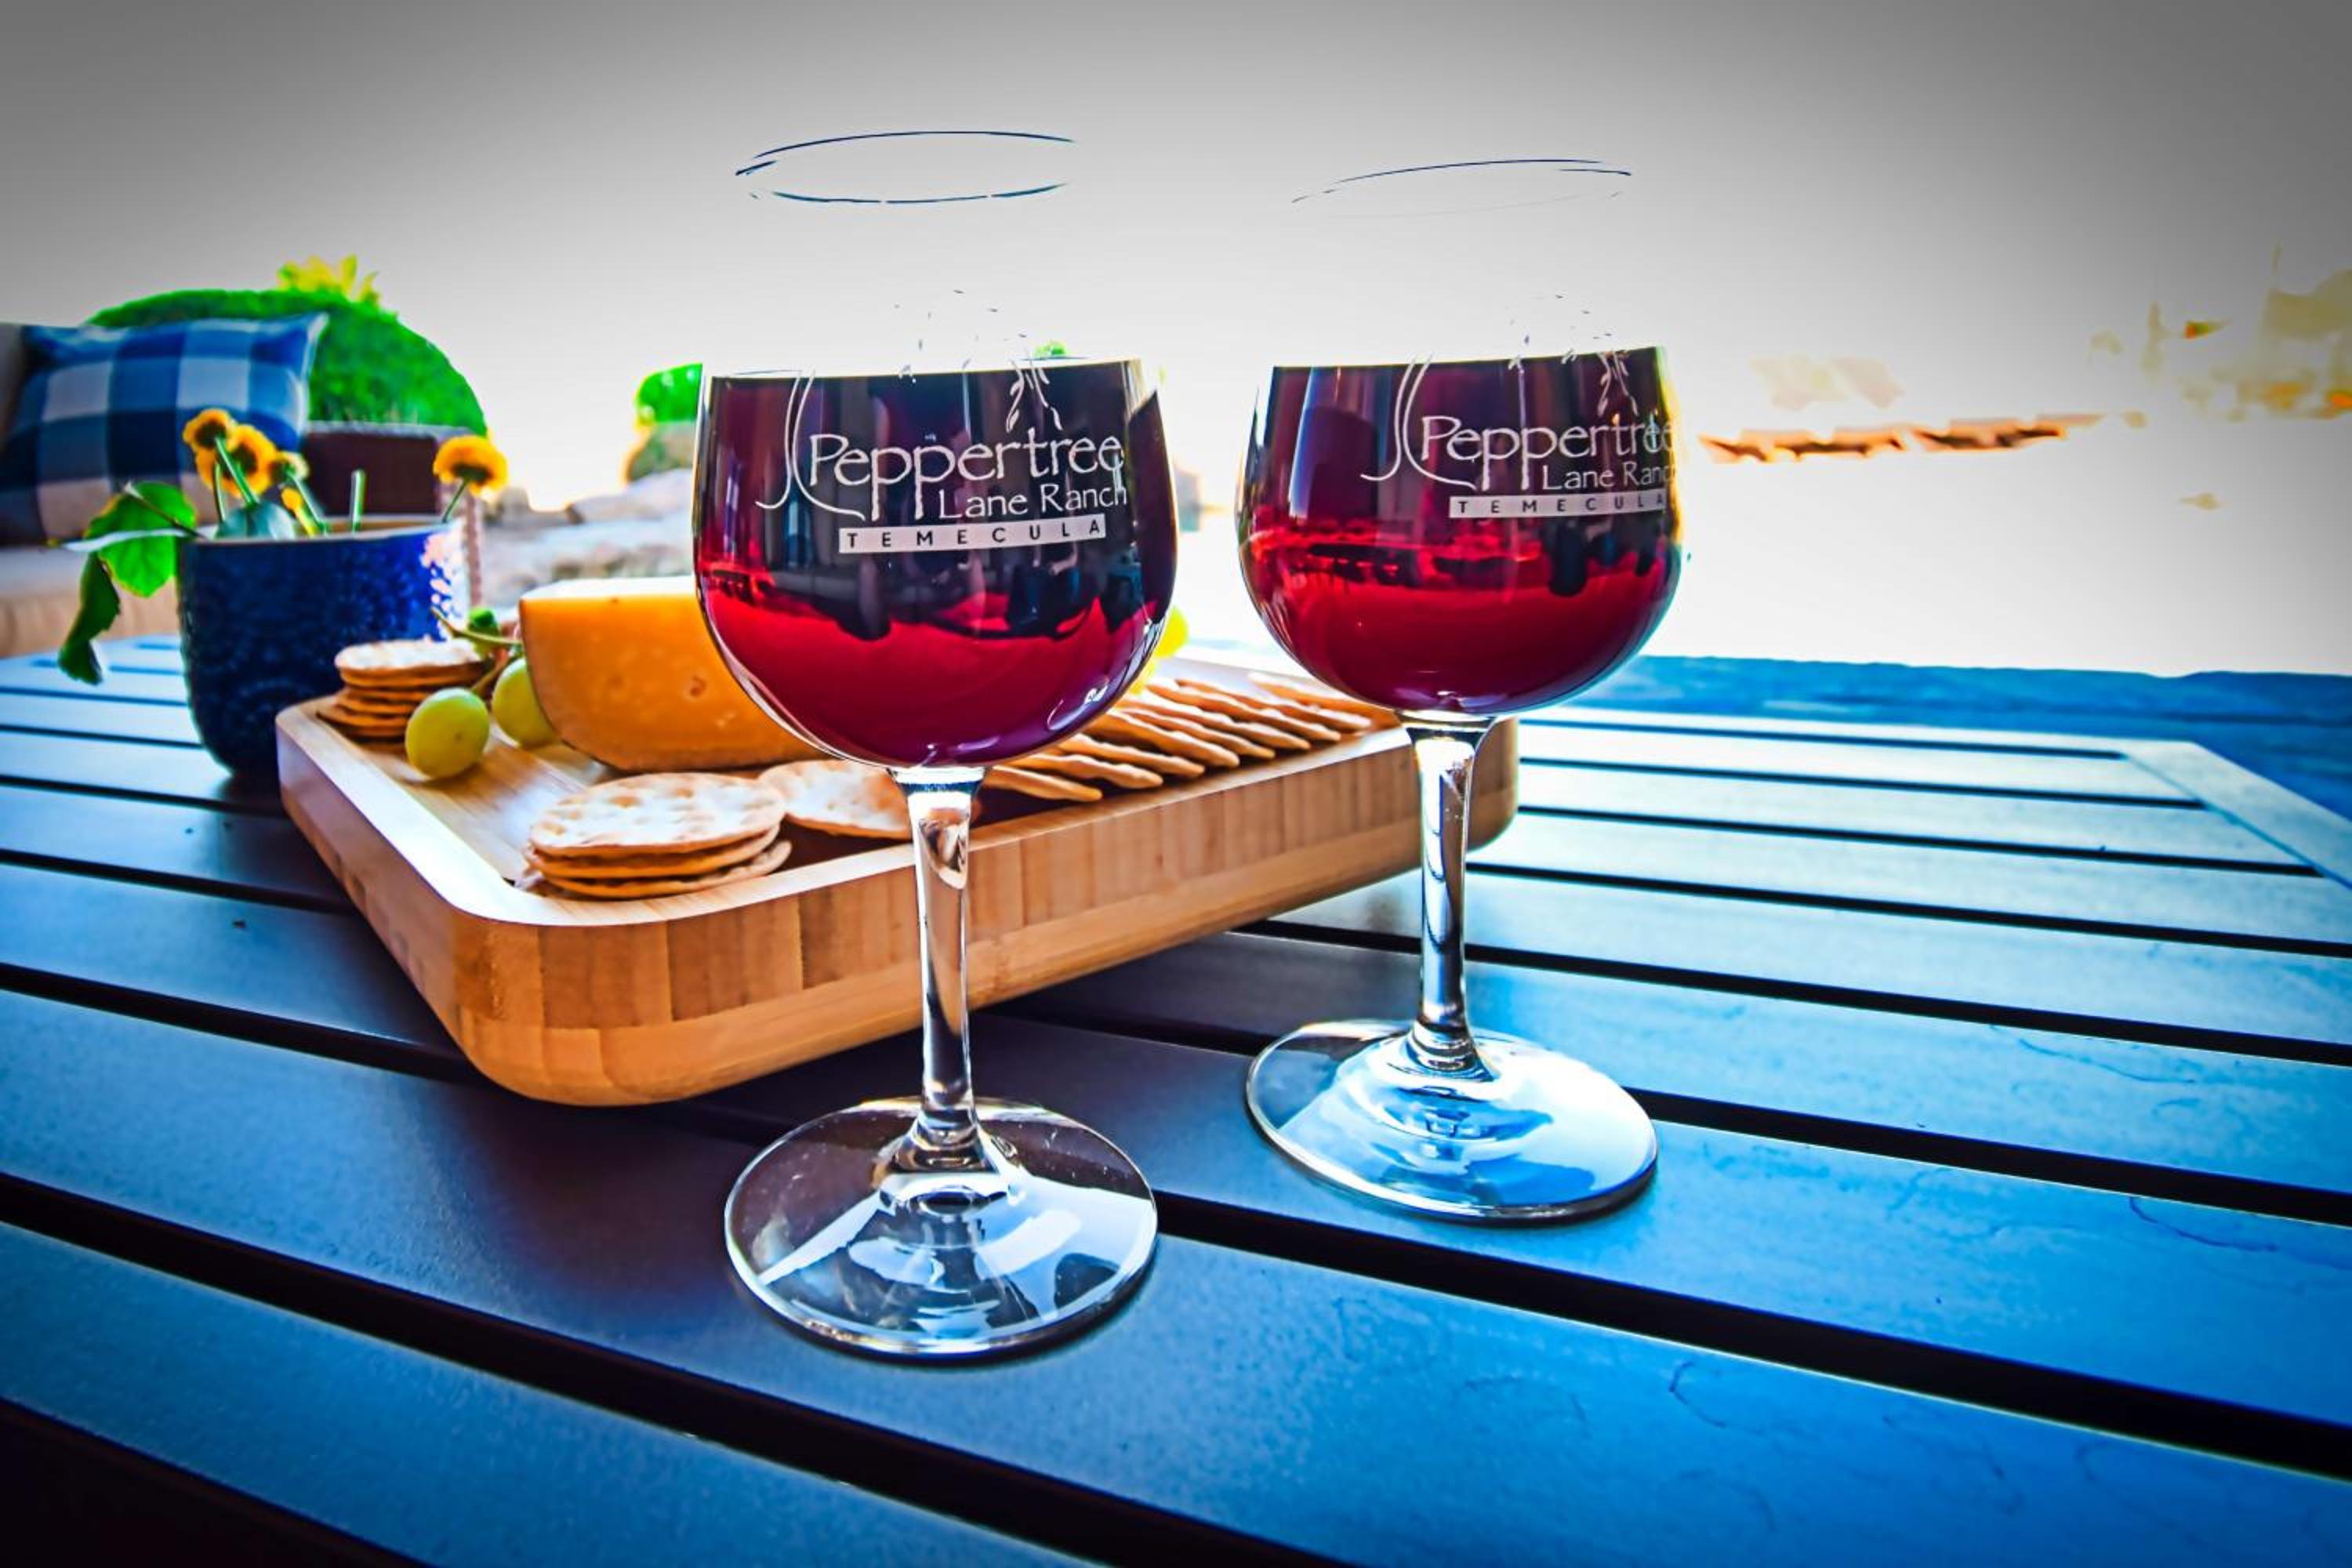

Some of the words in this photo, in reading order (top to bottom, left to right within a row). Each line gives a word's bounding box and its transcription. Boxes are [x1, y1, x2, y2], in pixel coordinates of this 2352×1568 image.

[1420, 413, 1675, 492] Peppertree
[809, 427, 1125, 521] Peppertree
[1541, 464, 1614, 491] Lane
[1622, 460, 1675, 487] Ranc
[938, 489, 1029, 521] Lane
[1040, 470, 1127, 513] Ranch
[1457, 492, 1664, 514] TEMECULA
[846, 517, 1101, 549] TEMECULA
